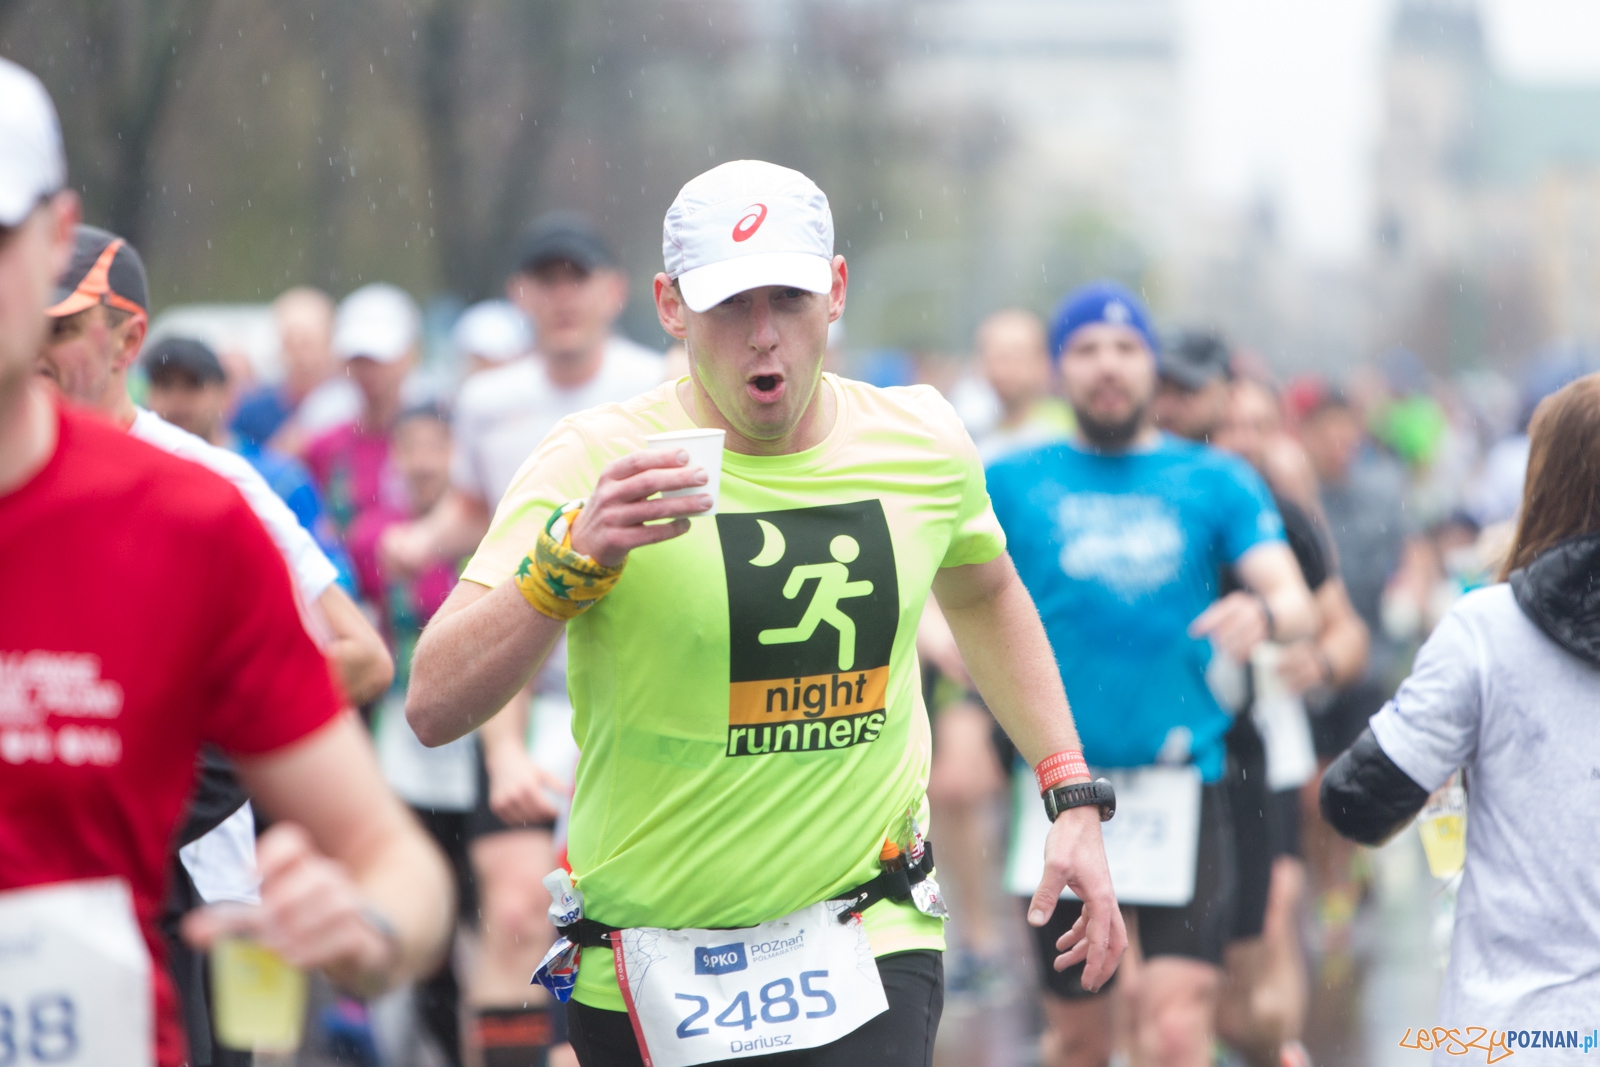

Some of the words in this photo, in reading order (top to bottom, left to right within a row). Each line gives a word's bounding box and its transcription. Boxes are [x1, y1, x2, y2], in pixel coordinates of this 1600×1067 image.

[766, 674, 867, 718] night
[728, 713, 887, 755] runners
[615, 946, 625, 981] 17.04.2016
[675, 970, 837, 1039] 2485
[730, 1034, 793, 1053] Dariusz
